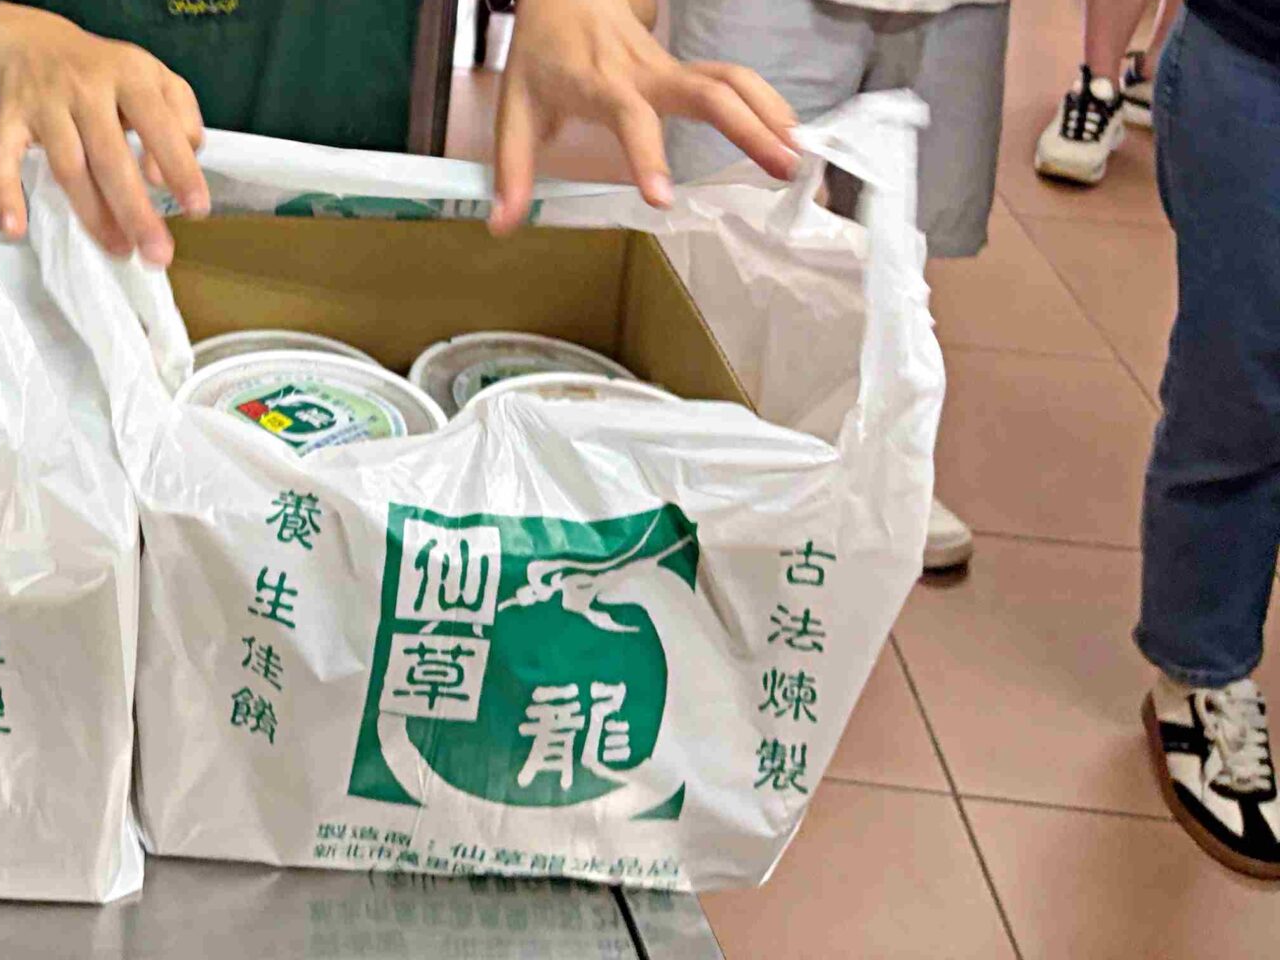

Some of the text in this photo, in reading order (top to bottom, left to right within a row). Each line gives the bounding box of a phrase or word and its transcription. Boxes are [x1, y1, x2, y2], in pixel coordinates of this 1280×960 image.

[230, 488, 322, 745] 養生佳餚
[391, 537, 634, 792] 仙草 龍
